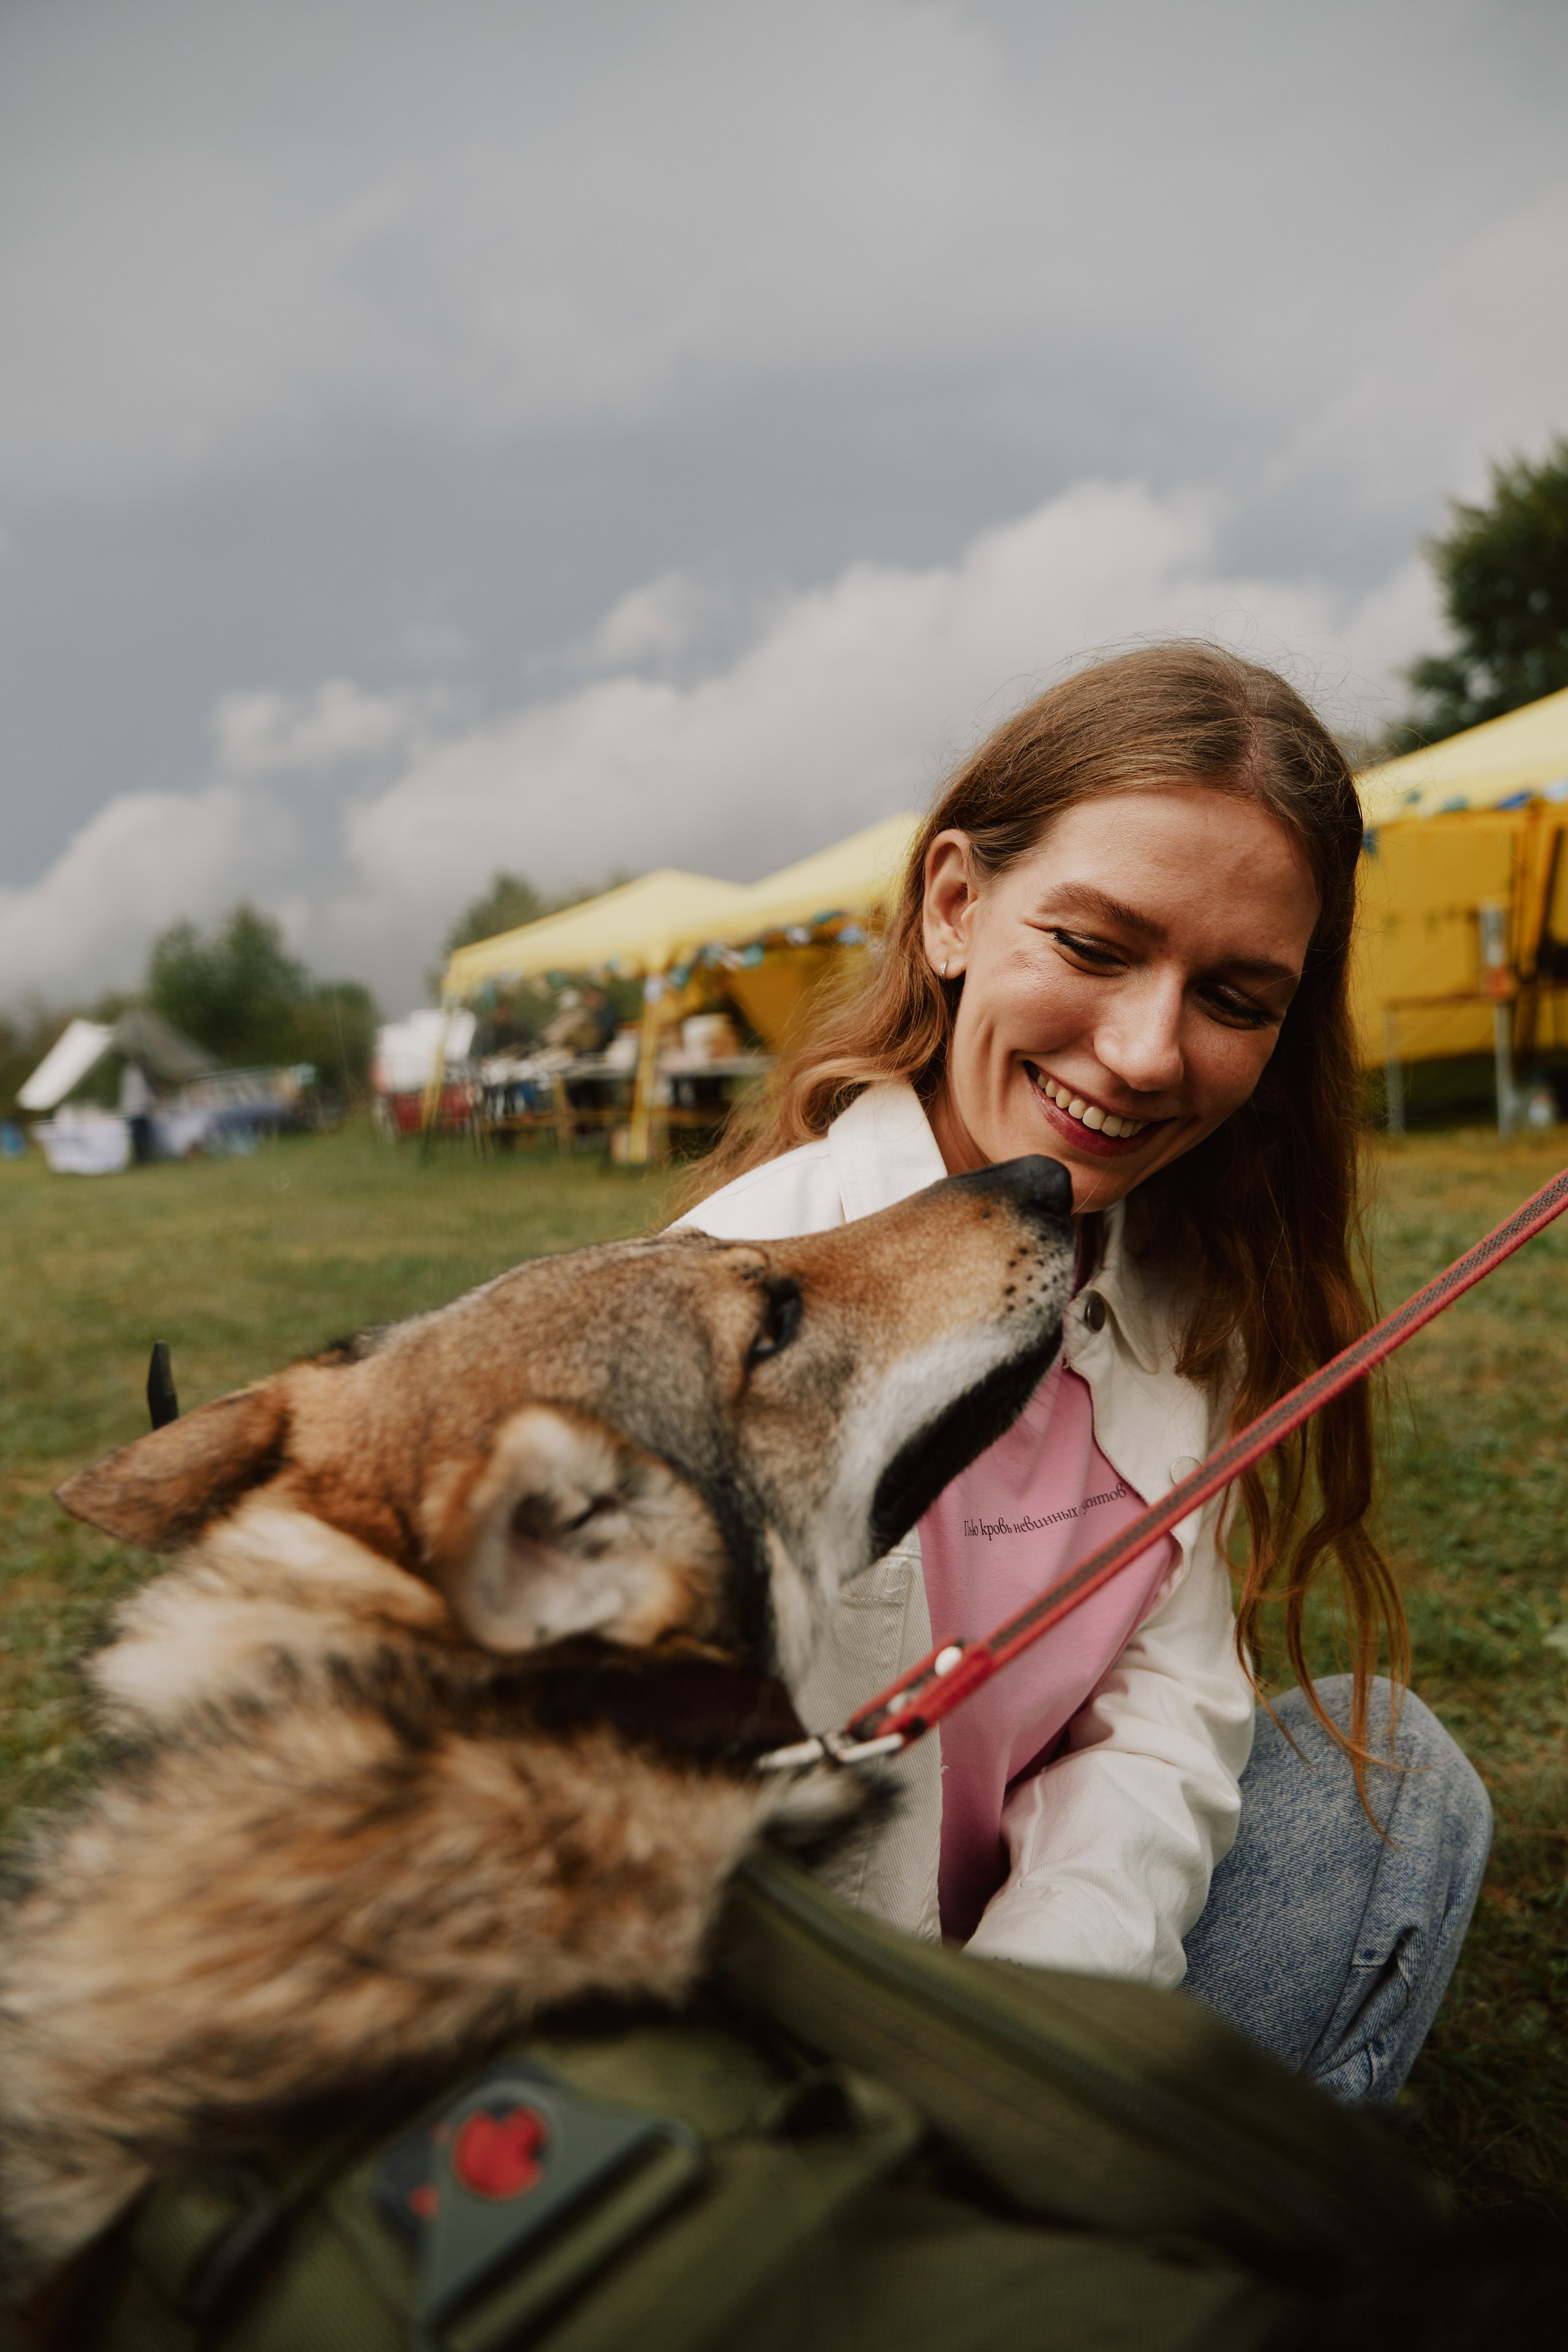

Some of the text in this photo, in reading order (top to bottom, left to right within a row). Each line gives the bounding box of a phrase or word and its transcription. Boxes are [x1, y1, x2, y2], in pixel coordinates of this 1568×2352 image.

[964, 1482, 1126, 1540] Пью кровь невинных дентов
